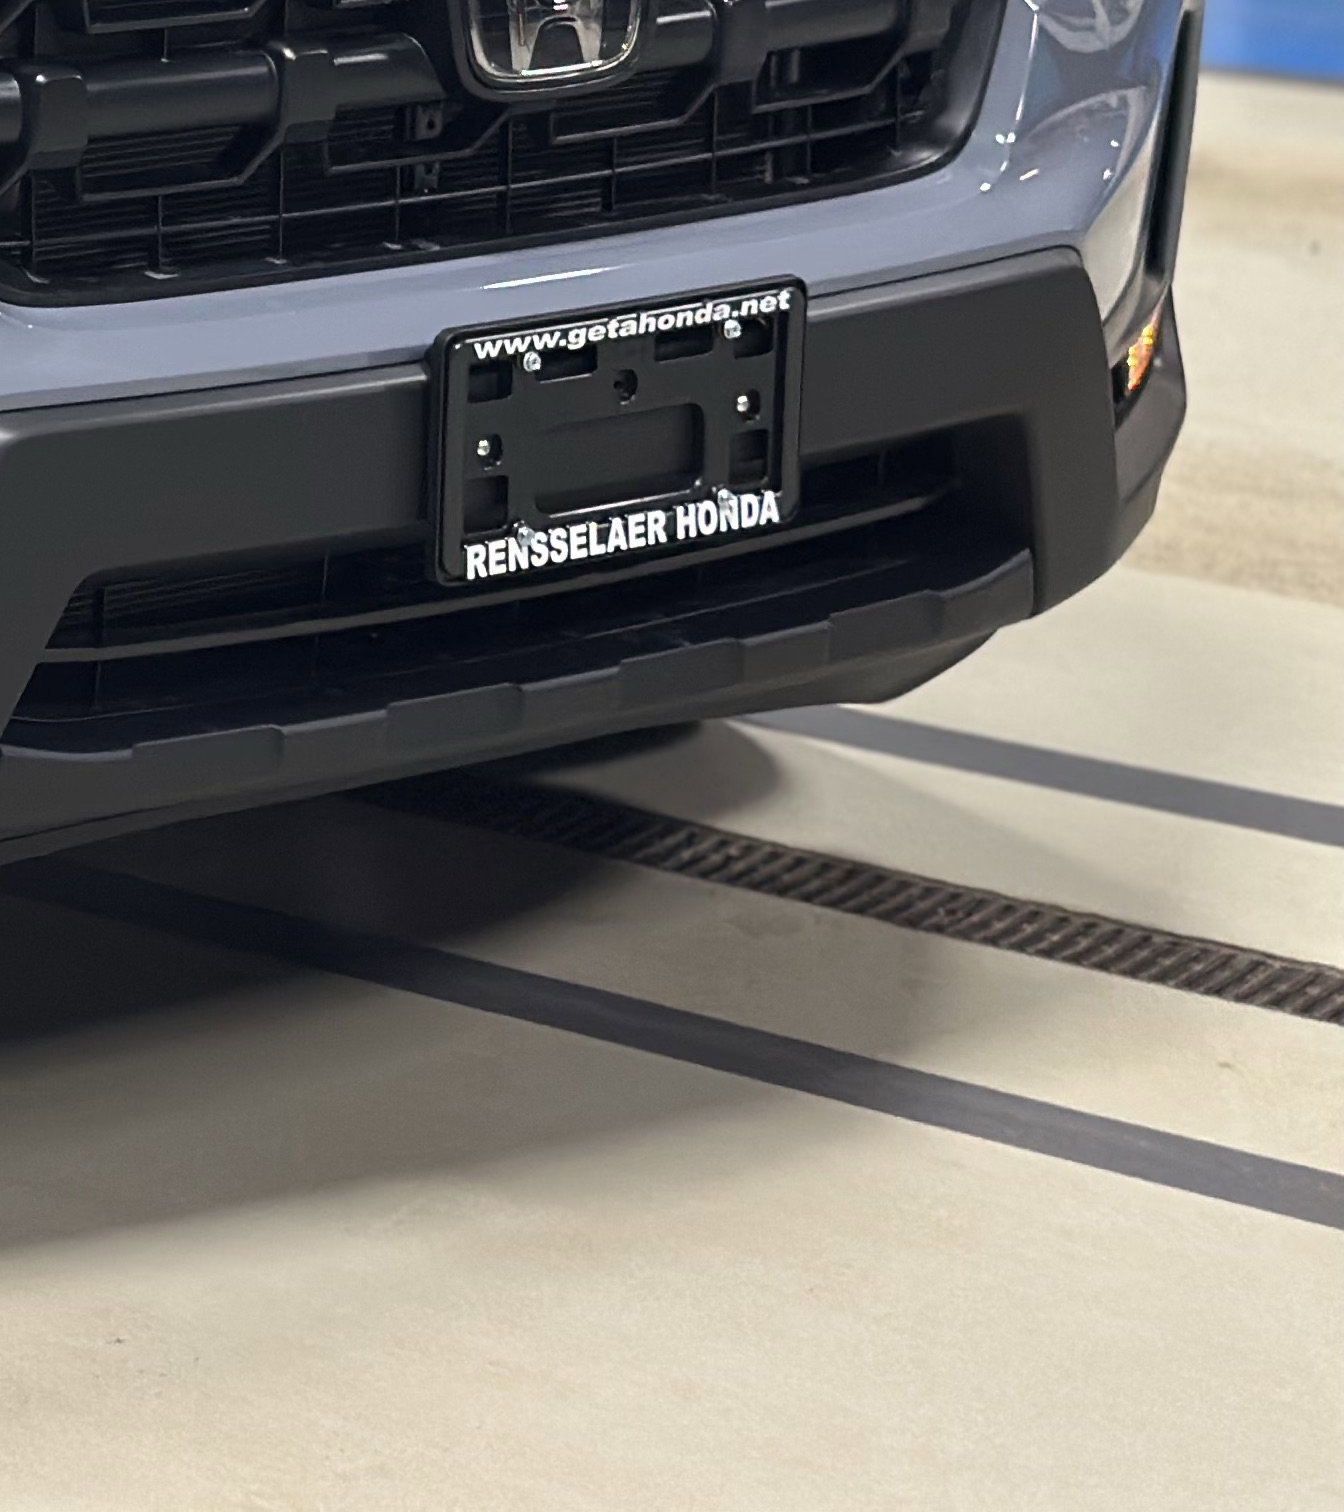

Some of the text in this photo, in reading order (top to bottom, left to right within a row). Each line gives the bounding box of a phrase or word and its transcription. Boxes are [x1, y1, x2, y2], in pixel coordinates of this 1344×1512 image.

[473, 291, 791, 359] www.getahonda.net
[465, 491, 780, 580] RENSSELAER HONDA
